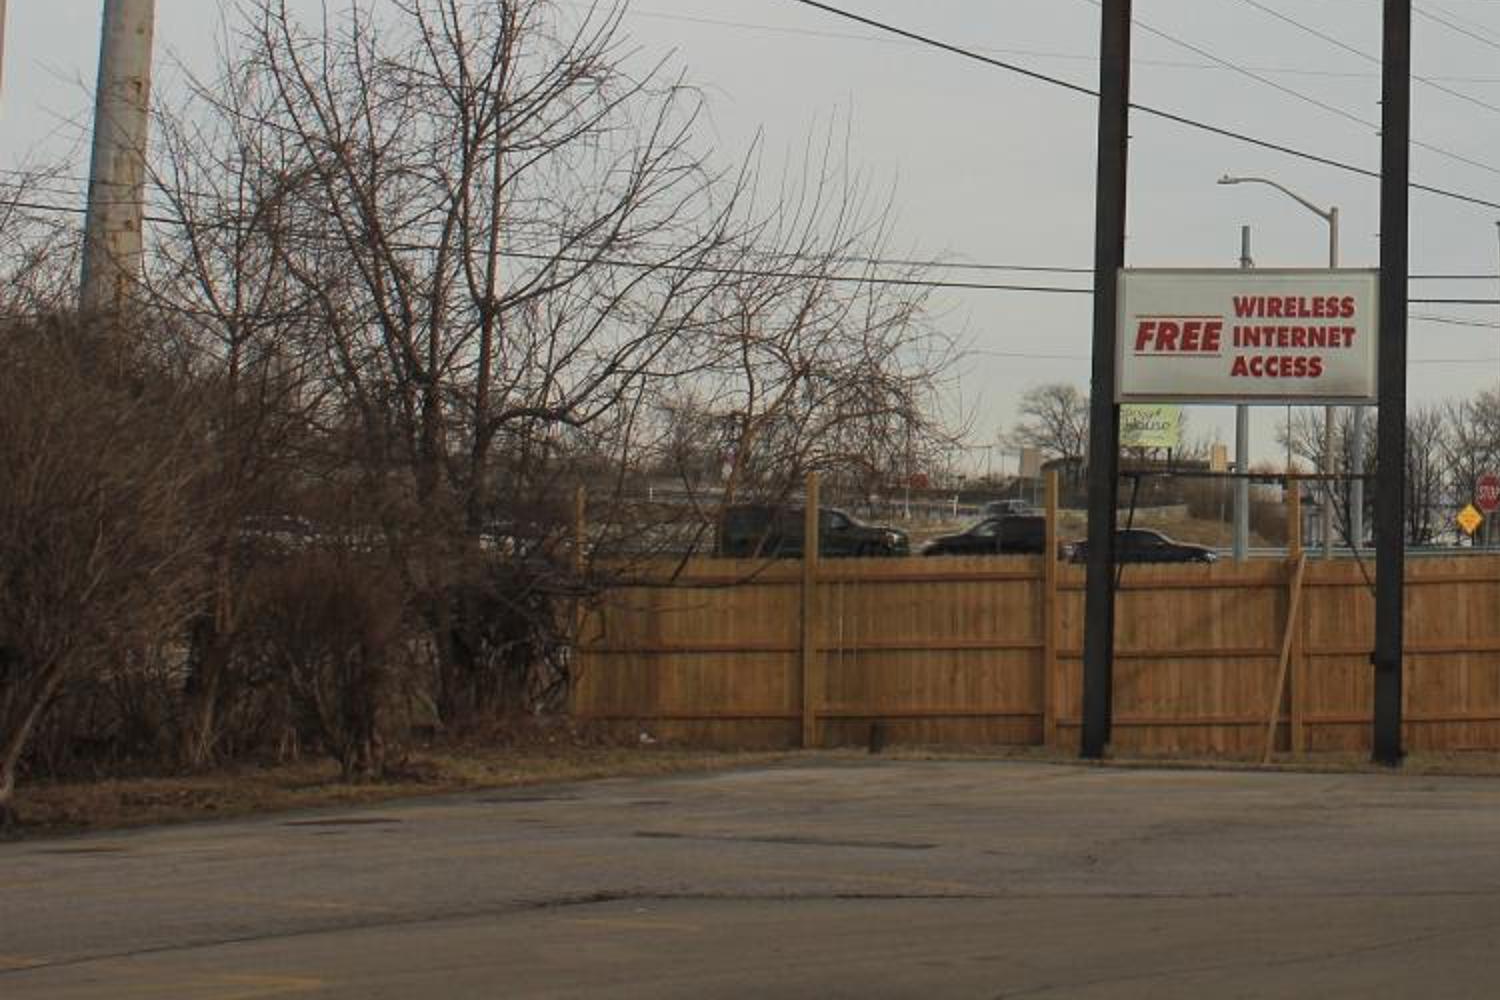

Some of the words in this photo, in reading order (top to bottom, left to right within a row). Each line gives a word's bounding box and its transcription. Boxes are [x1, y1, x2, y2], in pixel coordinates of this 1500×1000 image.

[1232, 296, 1356, 319] WIRELESS
[1134, 321, 1224, 352] FREE
[1232, 326, 1357, 348] INTERNET
[1230, 355, 1323, 378] ACCESS
